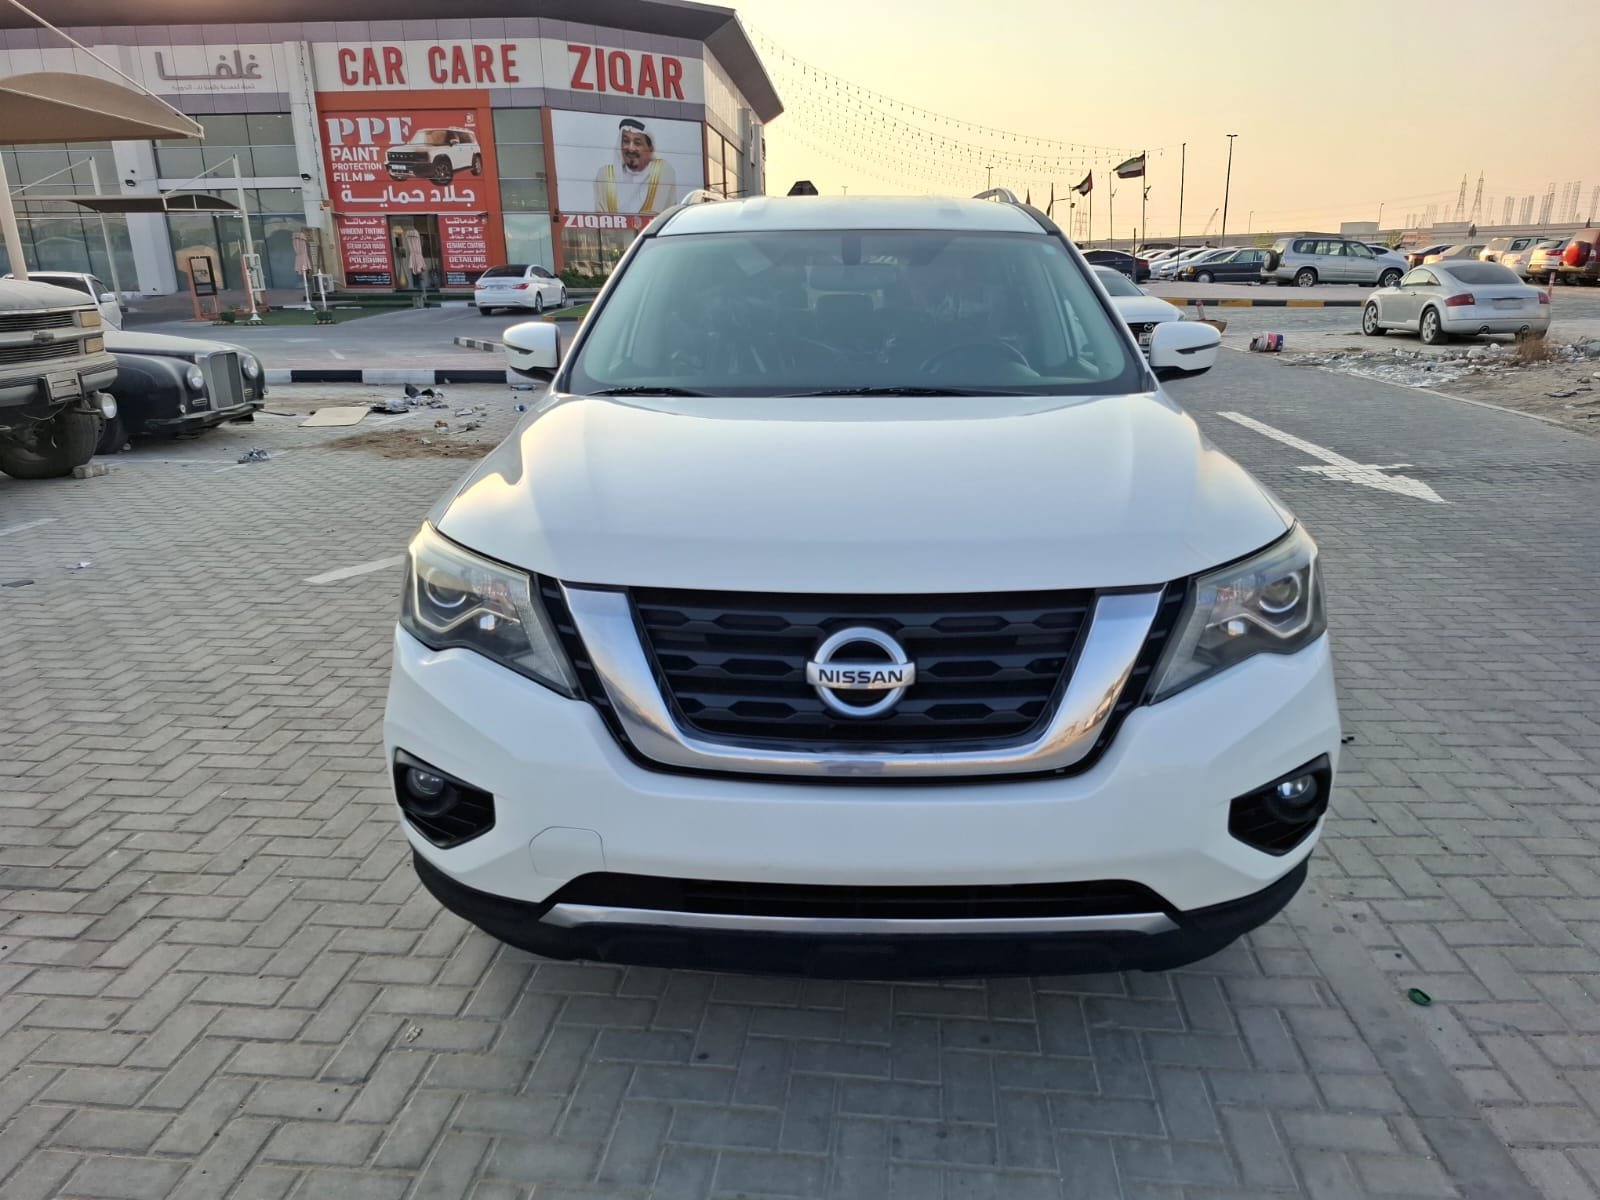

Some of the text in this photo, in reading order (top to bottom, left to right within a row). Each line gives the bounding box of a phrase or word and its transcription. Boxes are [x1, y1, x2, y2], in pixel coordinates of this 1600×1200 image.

[338, 44, 520, 86] CAR CARE
[567, 44, 685, 100] ZIQAR
[325, 117, 412, 146] PPF
[330, 147, 381, 161] PAINT
[332, 162, 383, 171] PROTECTION
[333, 172, 363, 182] FILM
[341, 184, 425, 208] حماية
[344, 217, 379, 225] خدماتنا
[563, 214, 628, 229] ZIQAR
[340, 227, 385, 235] WINDOW TINTING
[448, 226, 484, 234] PPF
[819, 669, 903, 684] NISSAN
